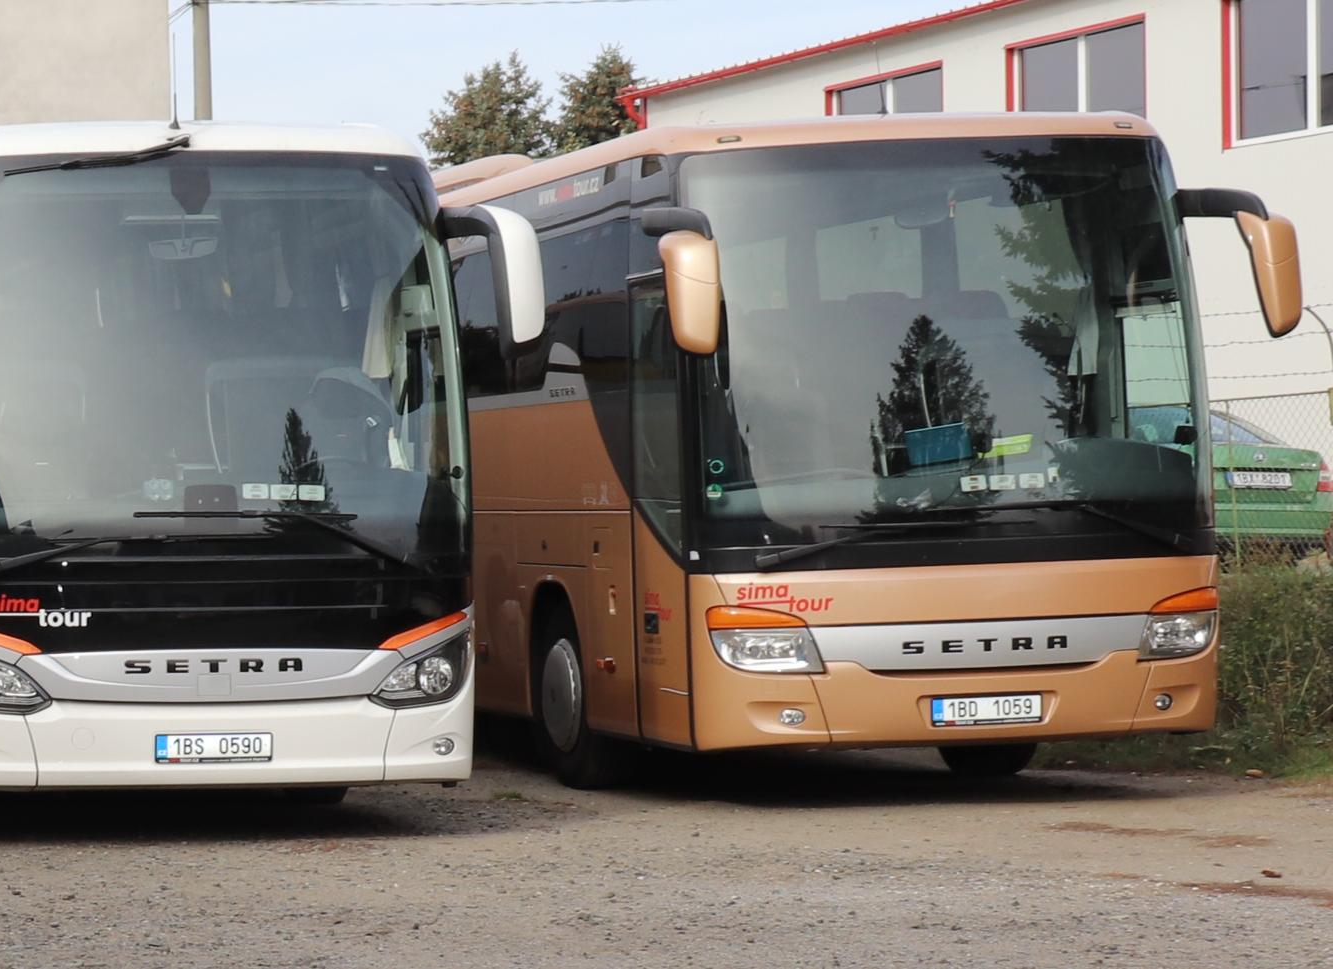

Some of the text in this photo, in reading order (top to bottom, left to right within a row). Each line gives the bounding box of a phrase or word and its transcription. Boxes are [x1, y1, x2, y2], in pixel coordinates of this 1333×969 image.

[737, 582, 789, 600] sima
[789, 595, 834, 612] tour
[38, 608, 92, 627] tour
[902, 635, 1068, 655] SETRA
[124, 657, 303, 674] SETRA
[948, 700, 978, 718] 1BD
[993, 698, 1033, 716] 1059
[173, 738, 204, 755] 1BS
[219, 737, 263, 754] 0590
